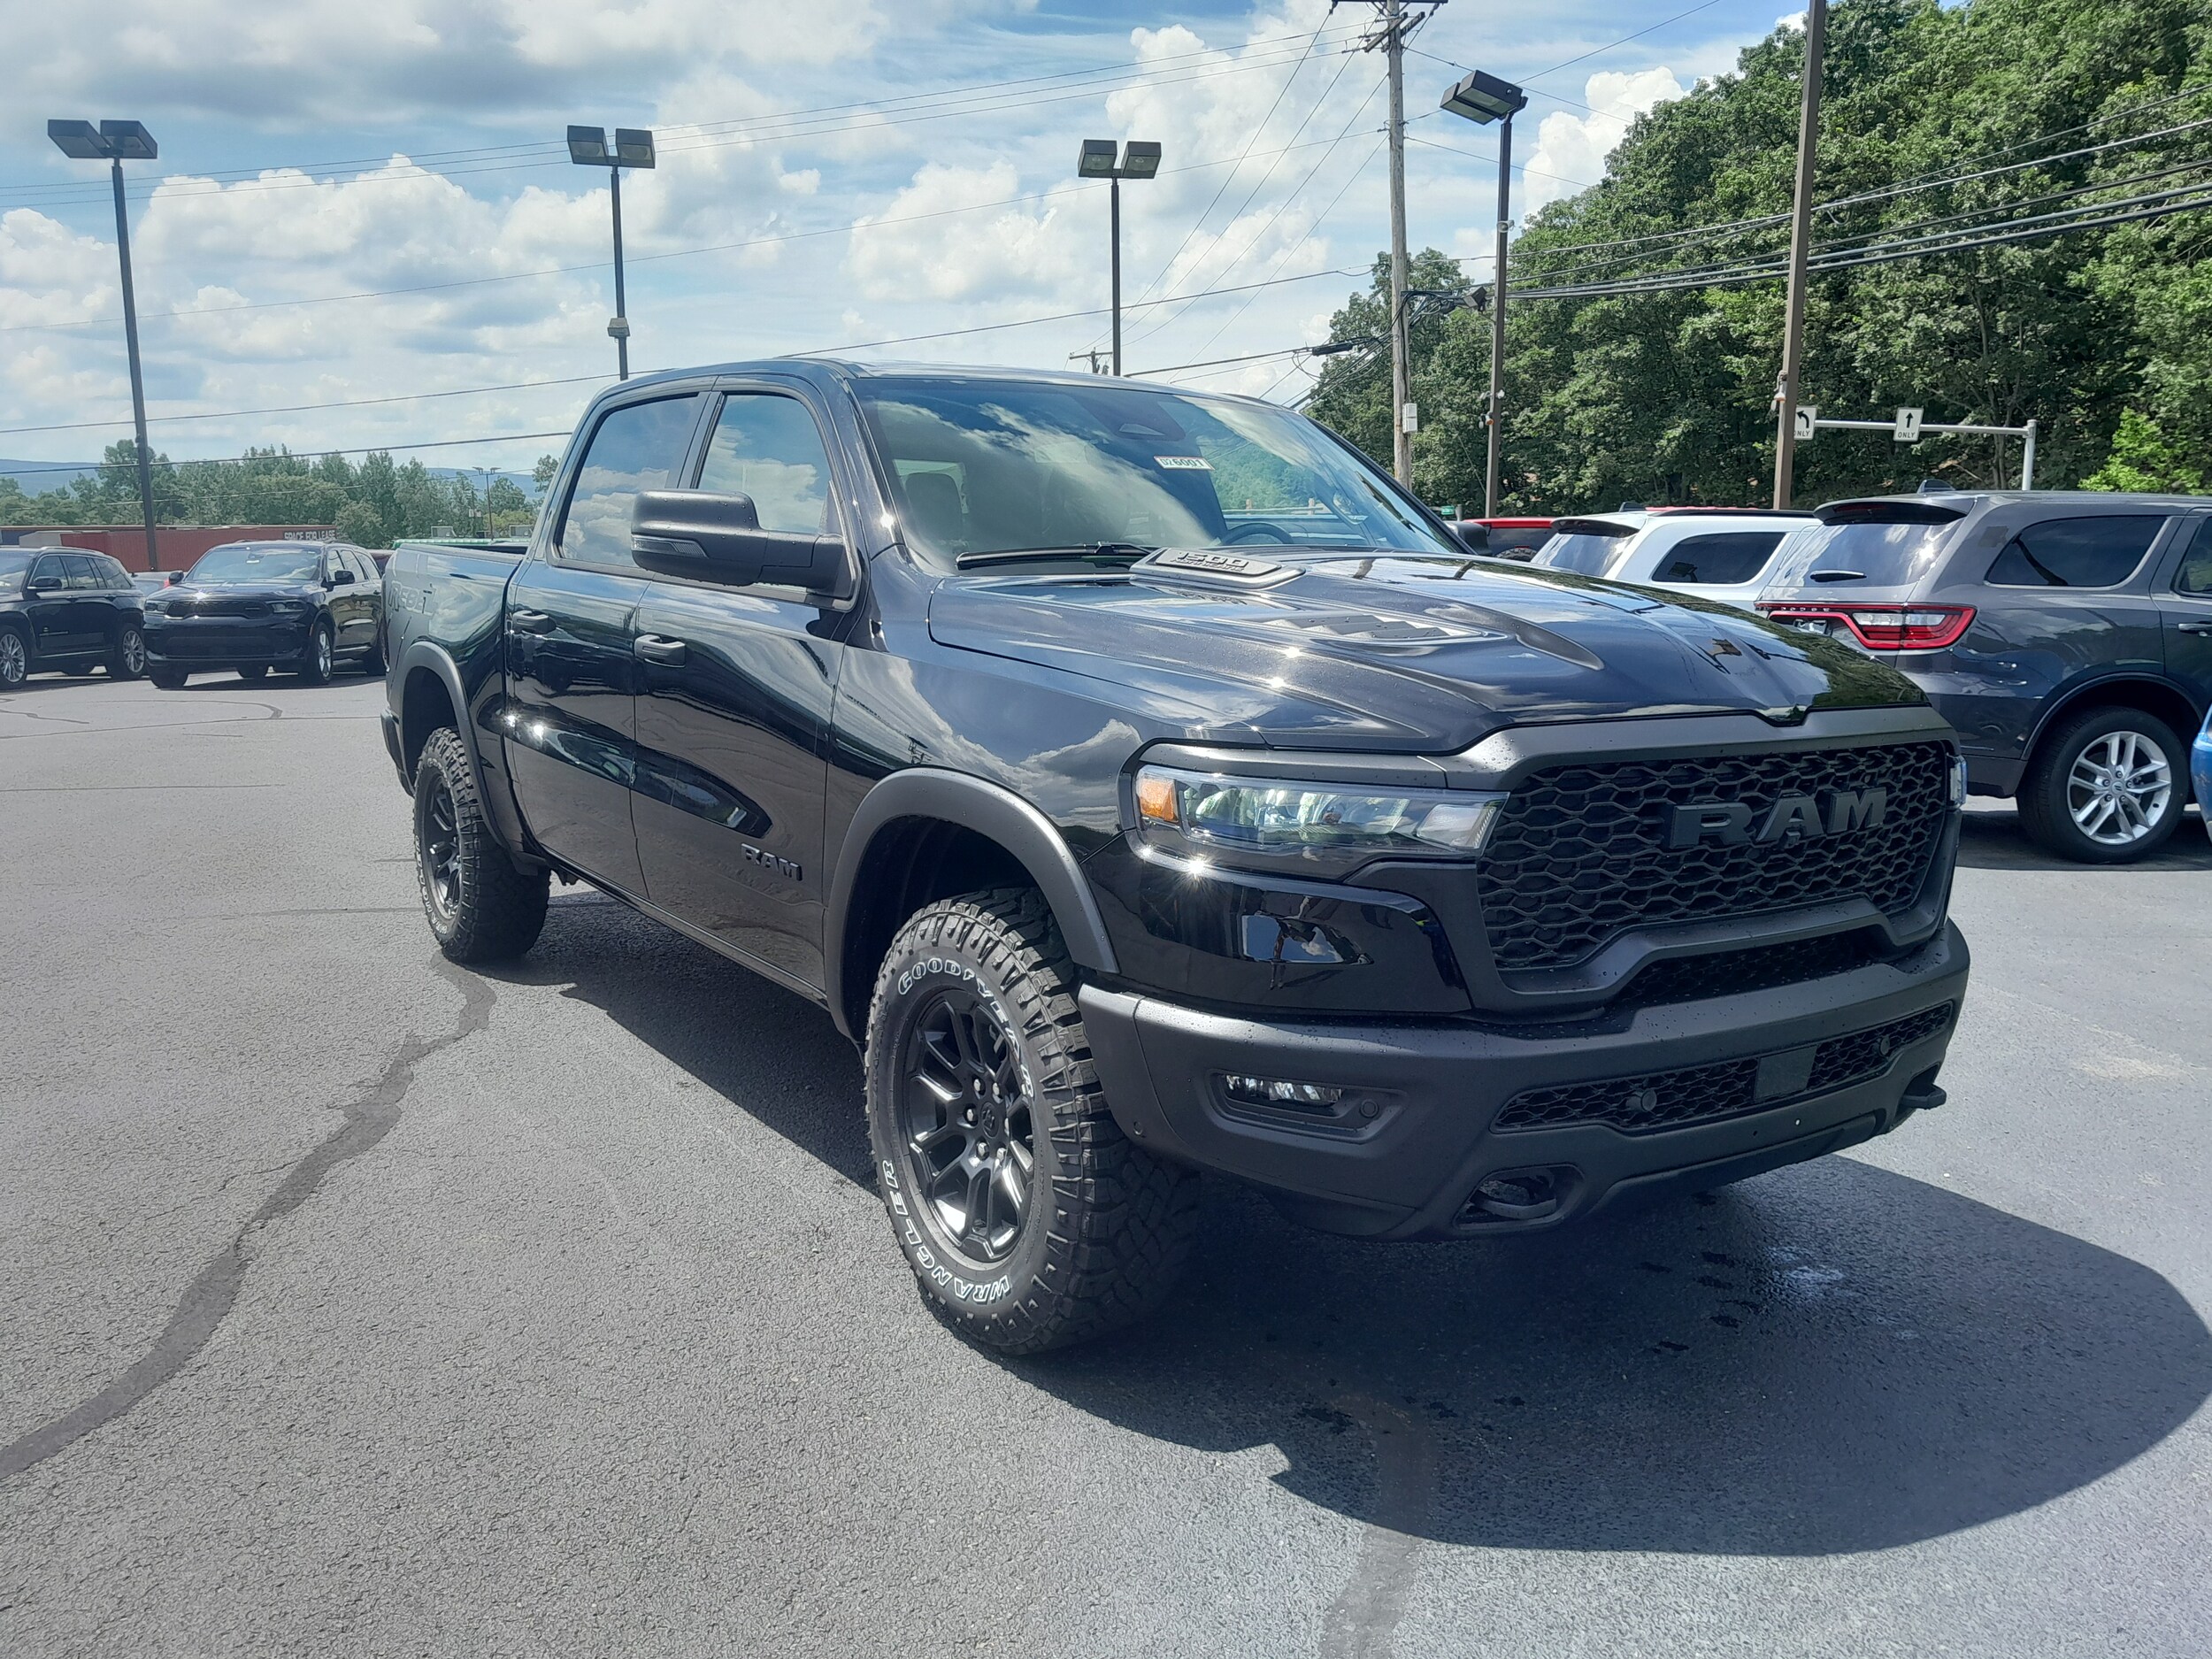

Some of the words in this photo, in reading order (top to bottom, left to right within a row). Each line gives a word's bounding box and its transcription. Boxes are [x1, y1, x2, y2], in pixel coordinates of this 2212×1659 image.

[284, 532, 303, 541] SPACE
[305, 531, 317, 541] FOR
[319, 530, 335, 540] LEASE
[1177, 551, 1249, 567] 1500
[389, 580, 437, 617] REBEL
[1669, 786, 1887, 849] RAM
[741, 842, 803, 881] RAM
[897, 956, 1034, 1099] GOODYEAR
[882, 1160, 1011, 1303] WRANGLER
